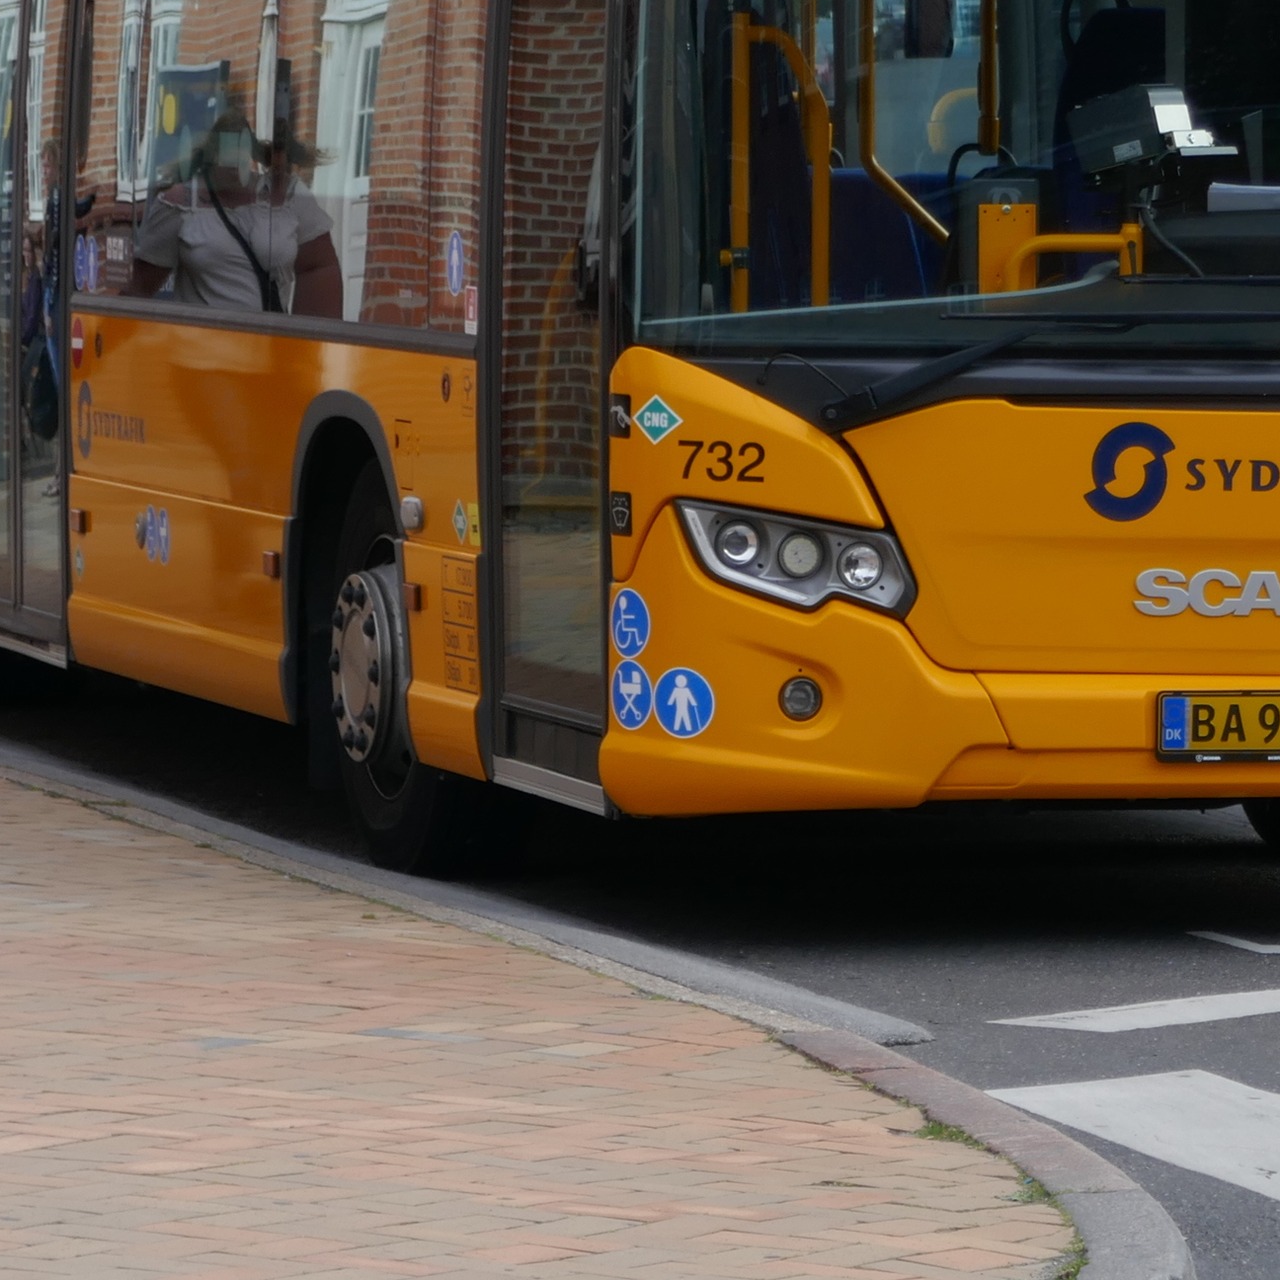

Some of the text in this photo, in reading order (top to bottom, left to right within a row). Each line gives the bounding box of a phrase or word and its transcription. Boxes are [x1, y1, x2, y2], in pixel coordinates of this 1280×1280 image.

[92, 410, 145, 444] SYDTRAFIK
[643, 411, 669, 429] CNG
[677, 439, 766, 483] 732
[1165, 728, 1182, 741] DK
[1191, 704, 1247, 743] BA
